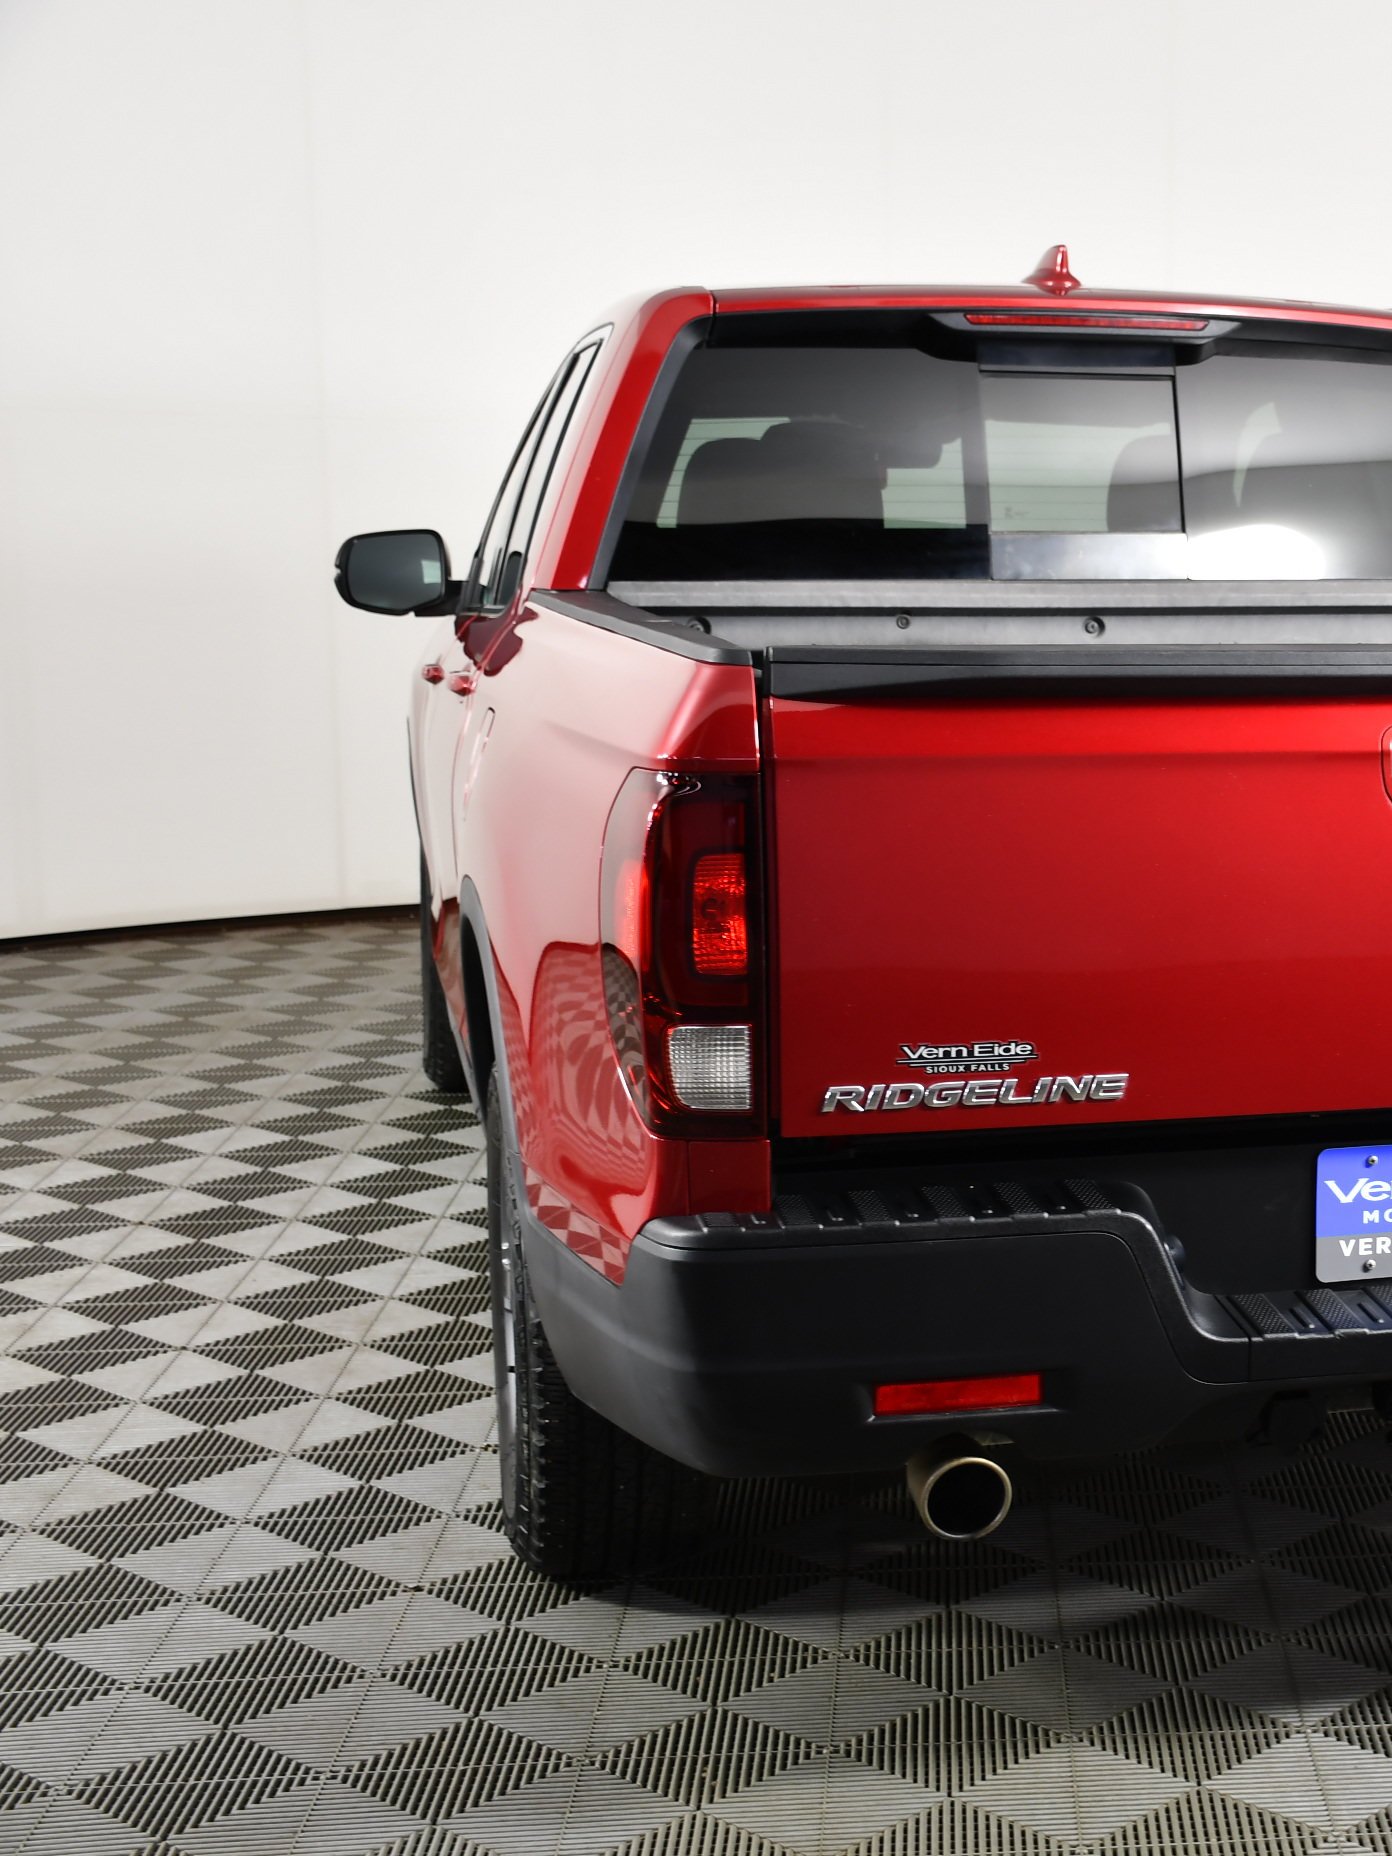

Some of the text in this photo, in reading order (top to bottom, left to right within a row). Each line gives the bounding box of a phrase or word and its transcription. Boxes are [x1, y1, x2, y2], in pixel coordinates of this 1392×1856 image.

[901, 1042, 1033, 1059] Vern Eide
[925, 1063, 1010, 1074] SIOUX FALLS
[821, 1073, 1129, 1113] RIDGELINE
